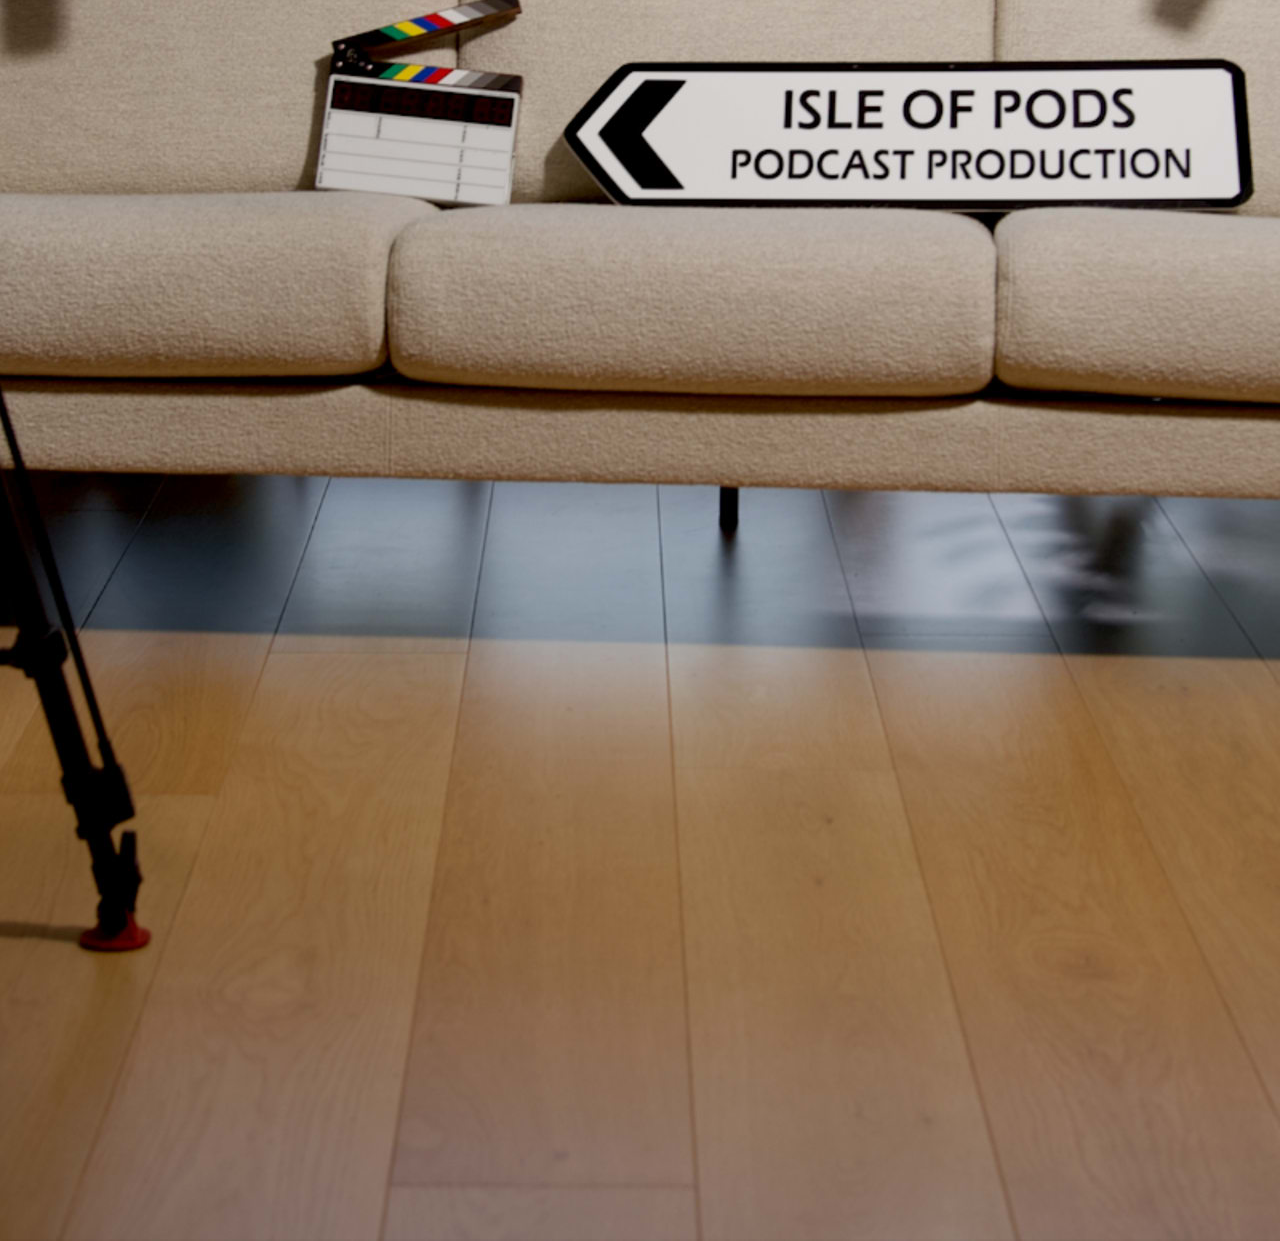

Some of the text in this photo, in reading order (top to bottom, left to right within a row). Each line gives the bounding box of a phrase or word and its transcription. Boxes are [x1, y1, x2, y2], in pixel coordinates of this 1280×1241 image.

[783, 88, 1137, 130] ISLE OF PODS
[731, 148, 1192, 180] PODCAST PRODUCTION
